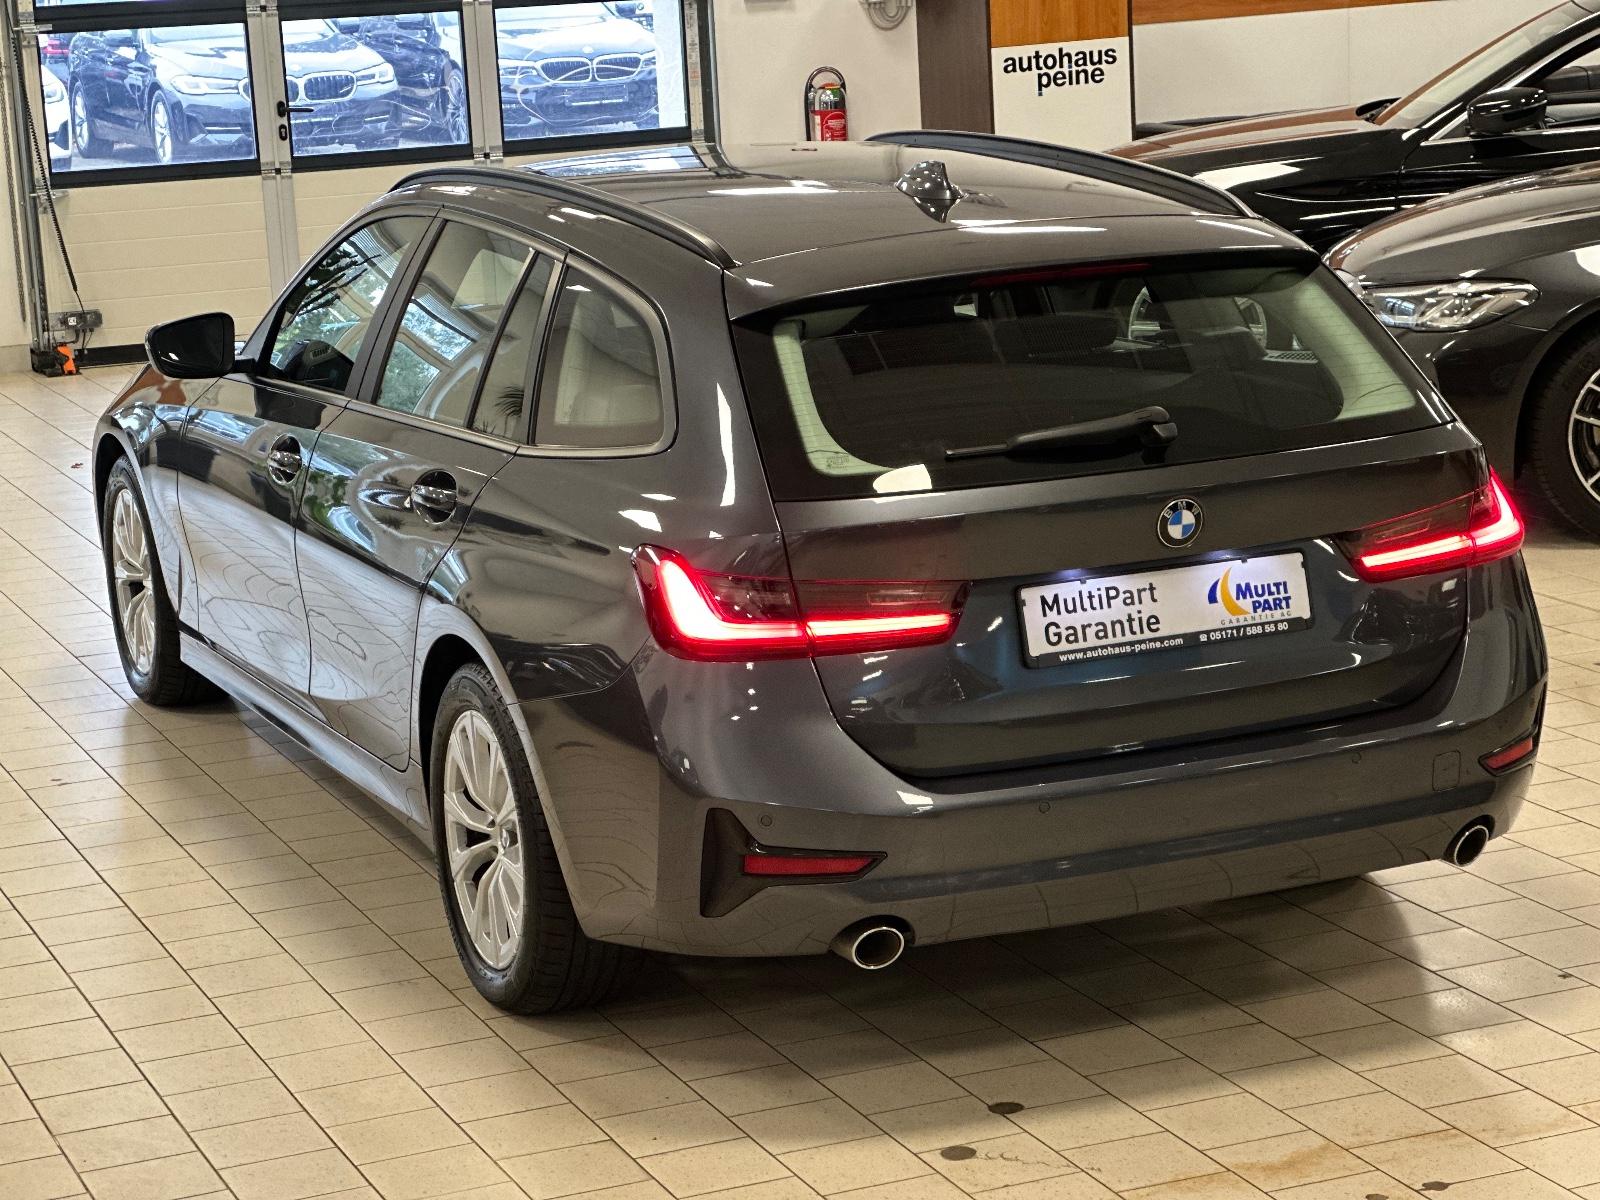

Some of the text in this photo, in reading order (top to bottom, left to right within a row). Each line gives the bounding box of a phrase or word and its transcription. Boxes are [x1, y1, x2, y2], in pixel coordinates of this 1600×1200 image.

[1003, 47, 1117, 73] autohaus
[1037, 63, 1105, 96] peine
[1163, 501, 1200, 518] BMW
[1040, 582, 1158, 617] MultiPart
[1236, 581, 1289, 600] MULTI
[1252, 595, 1291, 613] PART
[1044, 610, 1161, 647] Garantie
[1220, 613, 1275, 626] GARANTIE
[1209, 630, 1237, 640] 05171
[1265, 623, 1275, 632] 55
[1277, 622, 1288, 631] 80
[1059, 637, 1184, 662] www.autohaus-peine.com
